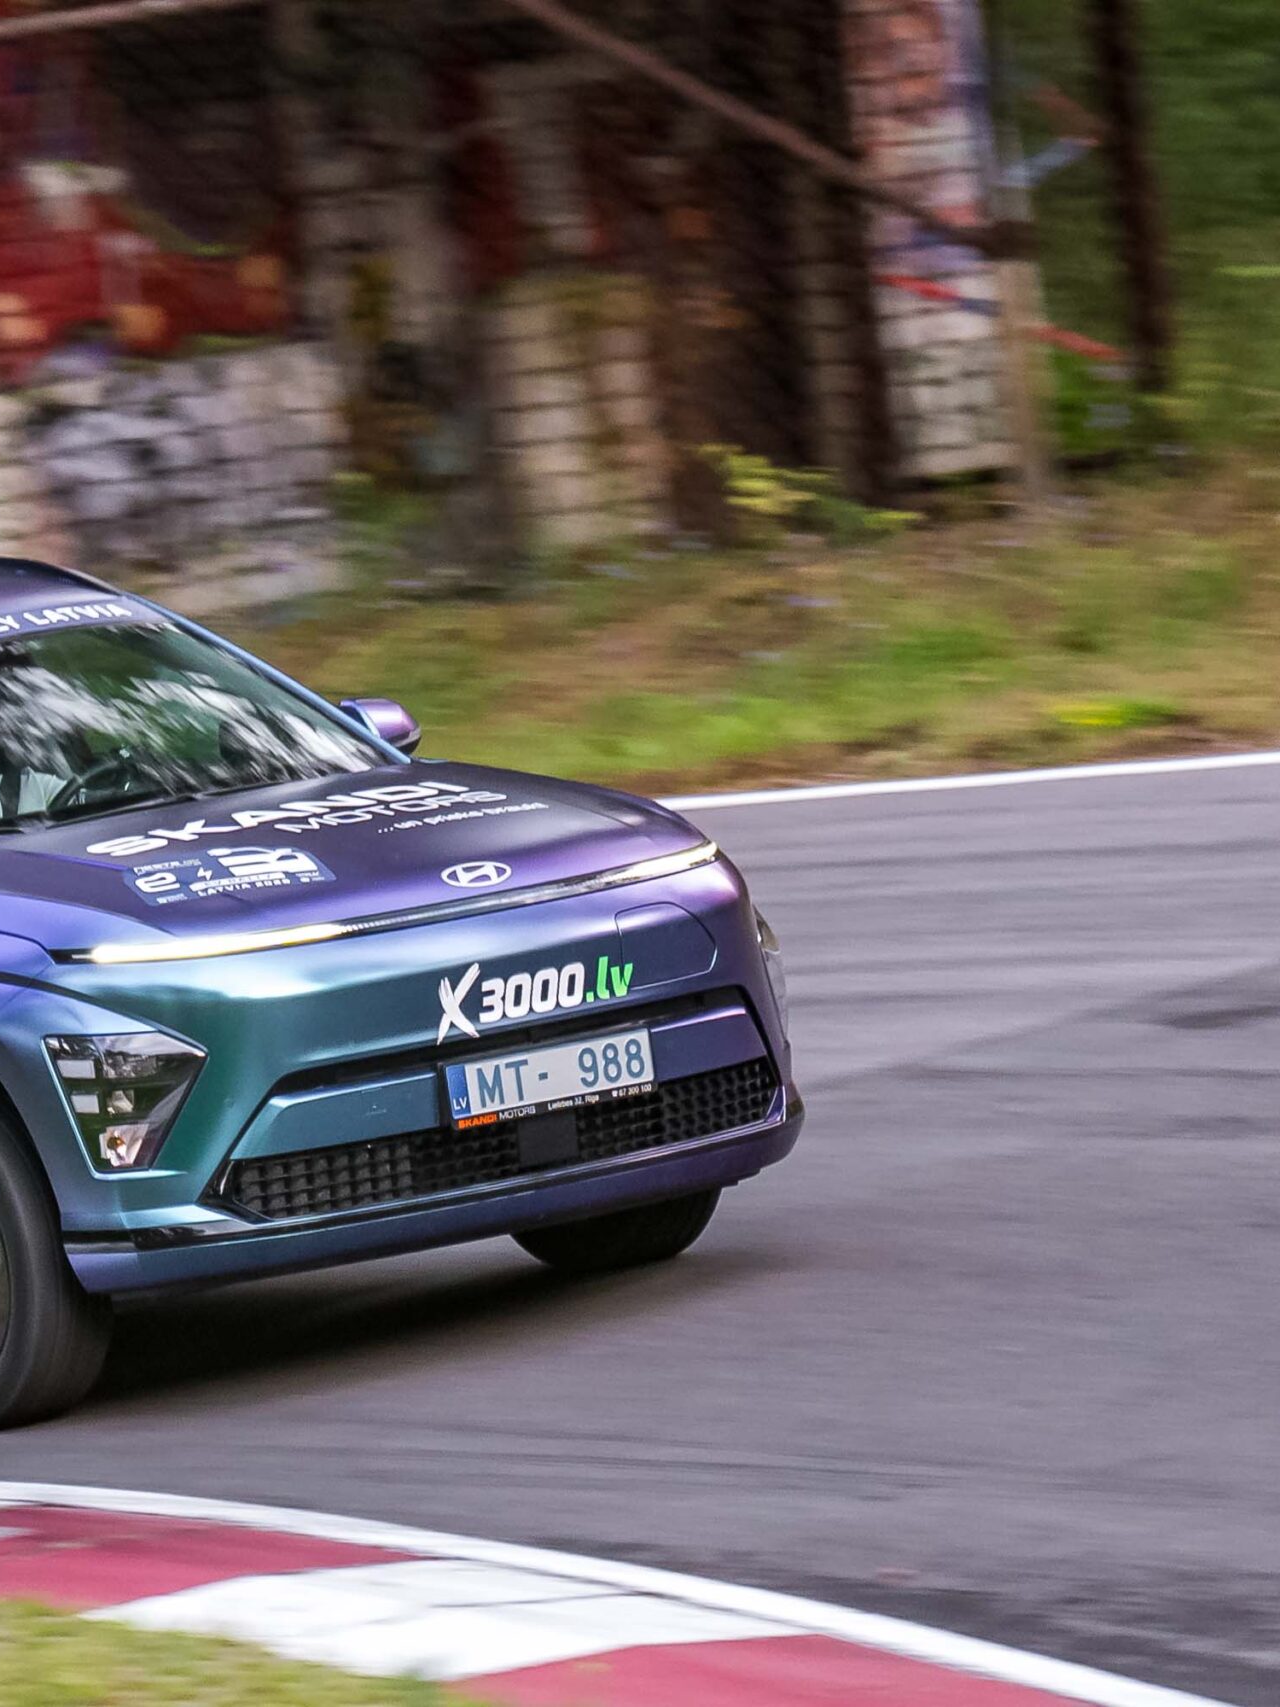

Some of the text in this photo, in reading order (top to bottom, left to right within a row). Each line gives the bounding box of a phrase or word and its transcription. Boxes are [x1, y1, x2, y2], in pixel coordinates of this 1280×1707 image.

[23, 603, 132, 626] LATVIA
[86, 781, 470, 857] SKANDI
[274, 790, 507, 833] MOTORS
[197, 882, 251, 897] LATVIA
[578, 1038, 645, 1088] 988
[453, 1096, 468, 1110] LV
[458, 1113, 497, 1130] SKANDI
[499, 1106, 536, 1121] MOTORS
